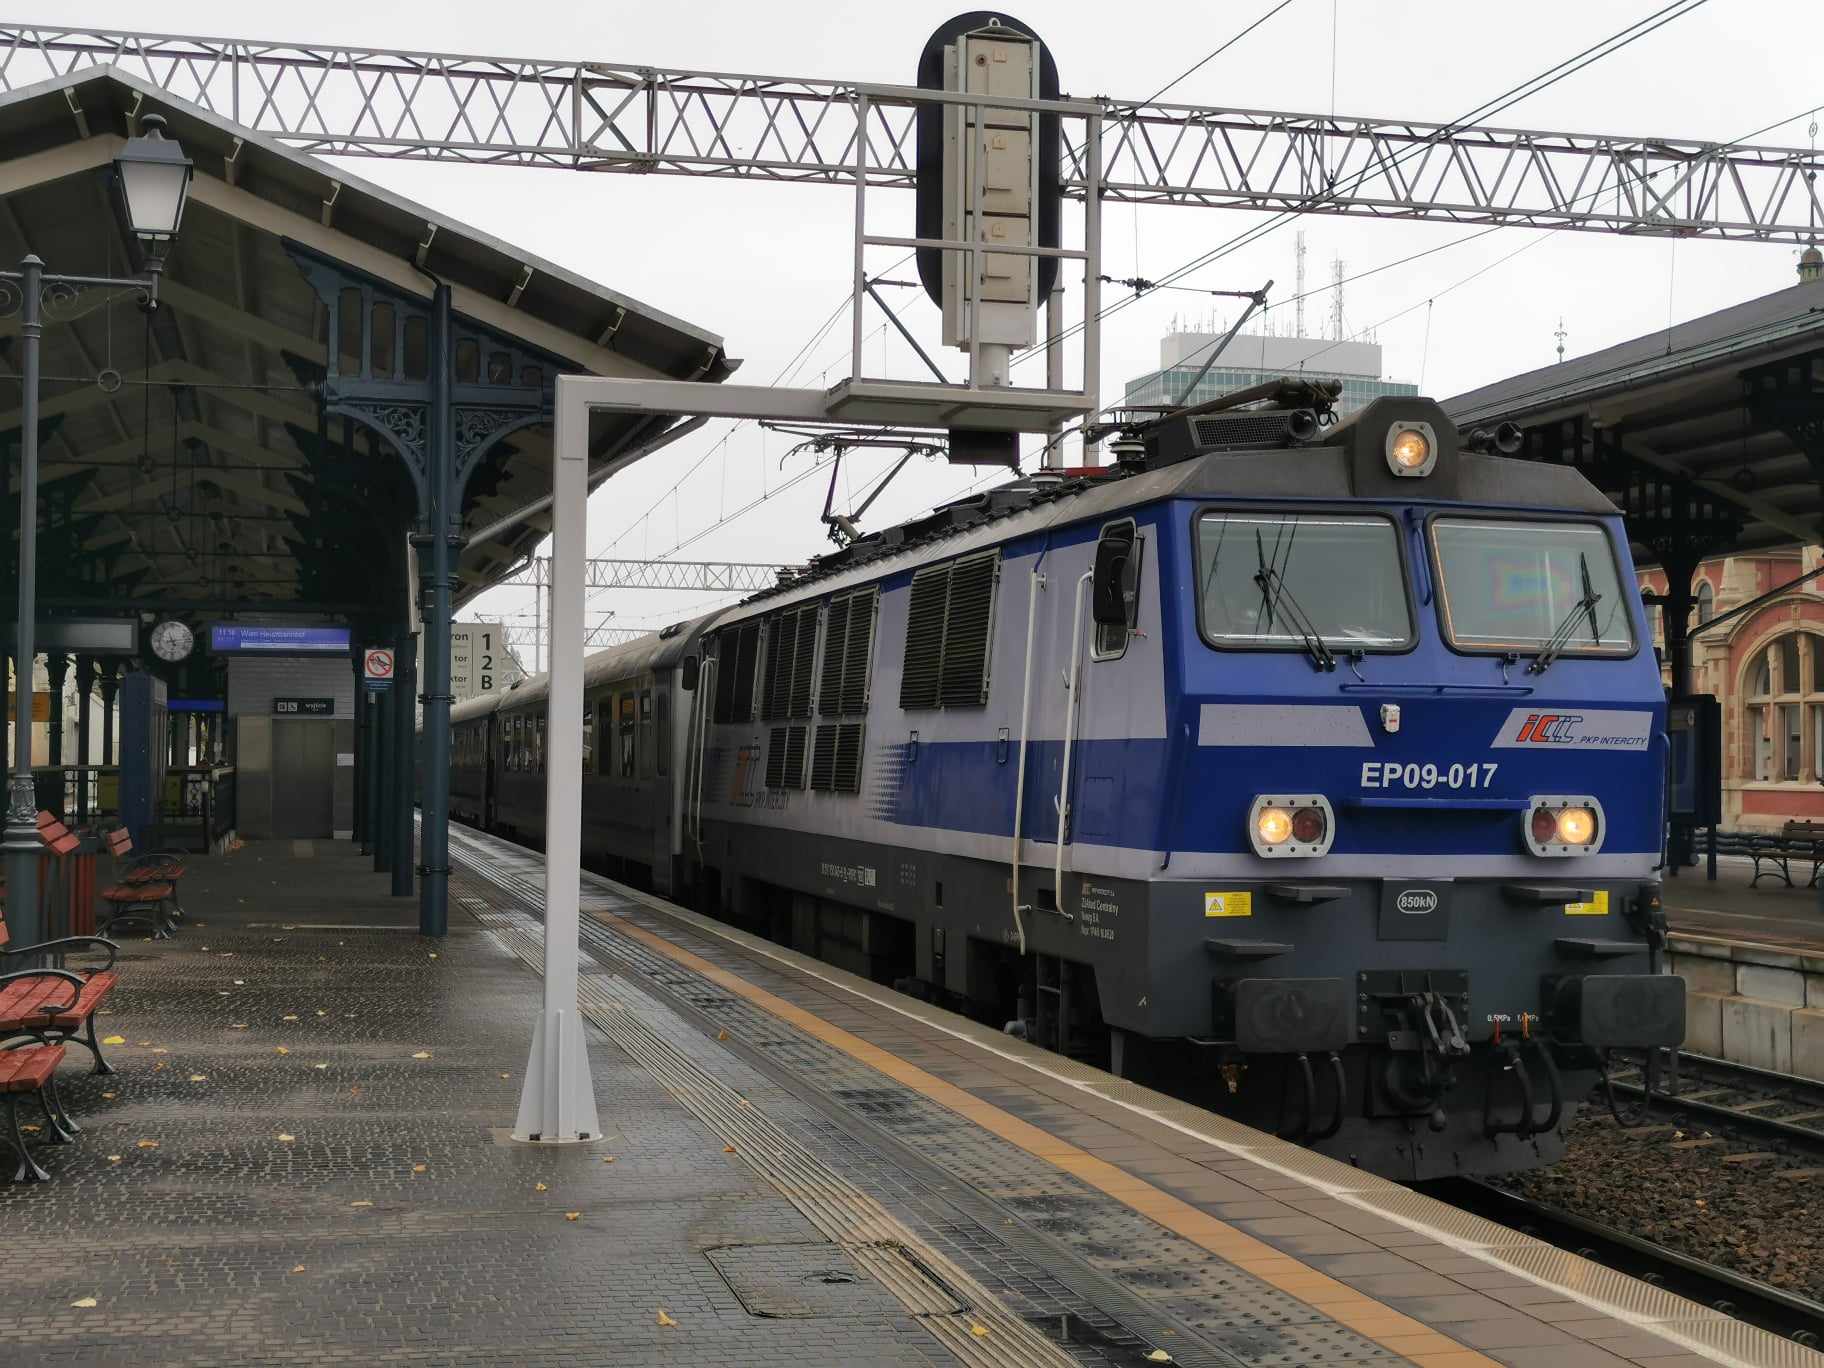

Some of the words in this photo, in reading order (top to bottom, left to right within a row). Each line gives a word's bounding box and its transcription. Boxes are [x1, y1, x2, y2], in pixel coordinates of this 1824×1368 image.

[481, 633, 491, 651] 1
[481, 655, 493, 671] 2
[481, 675, 493, 690] B
[1601, 737, 1648, 746] INTERCITY
[1360, 762, 1498, 789] EP09-017
[1400, 895, 1435, 910] 850kN
